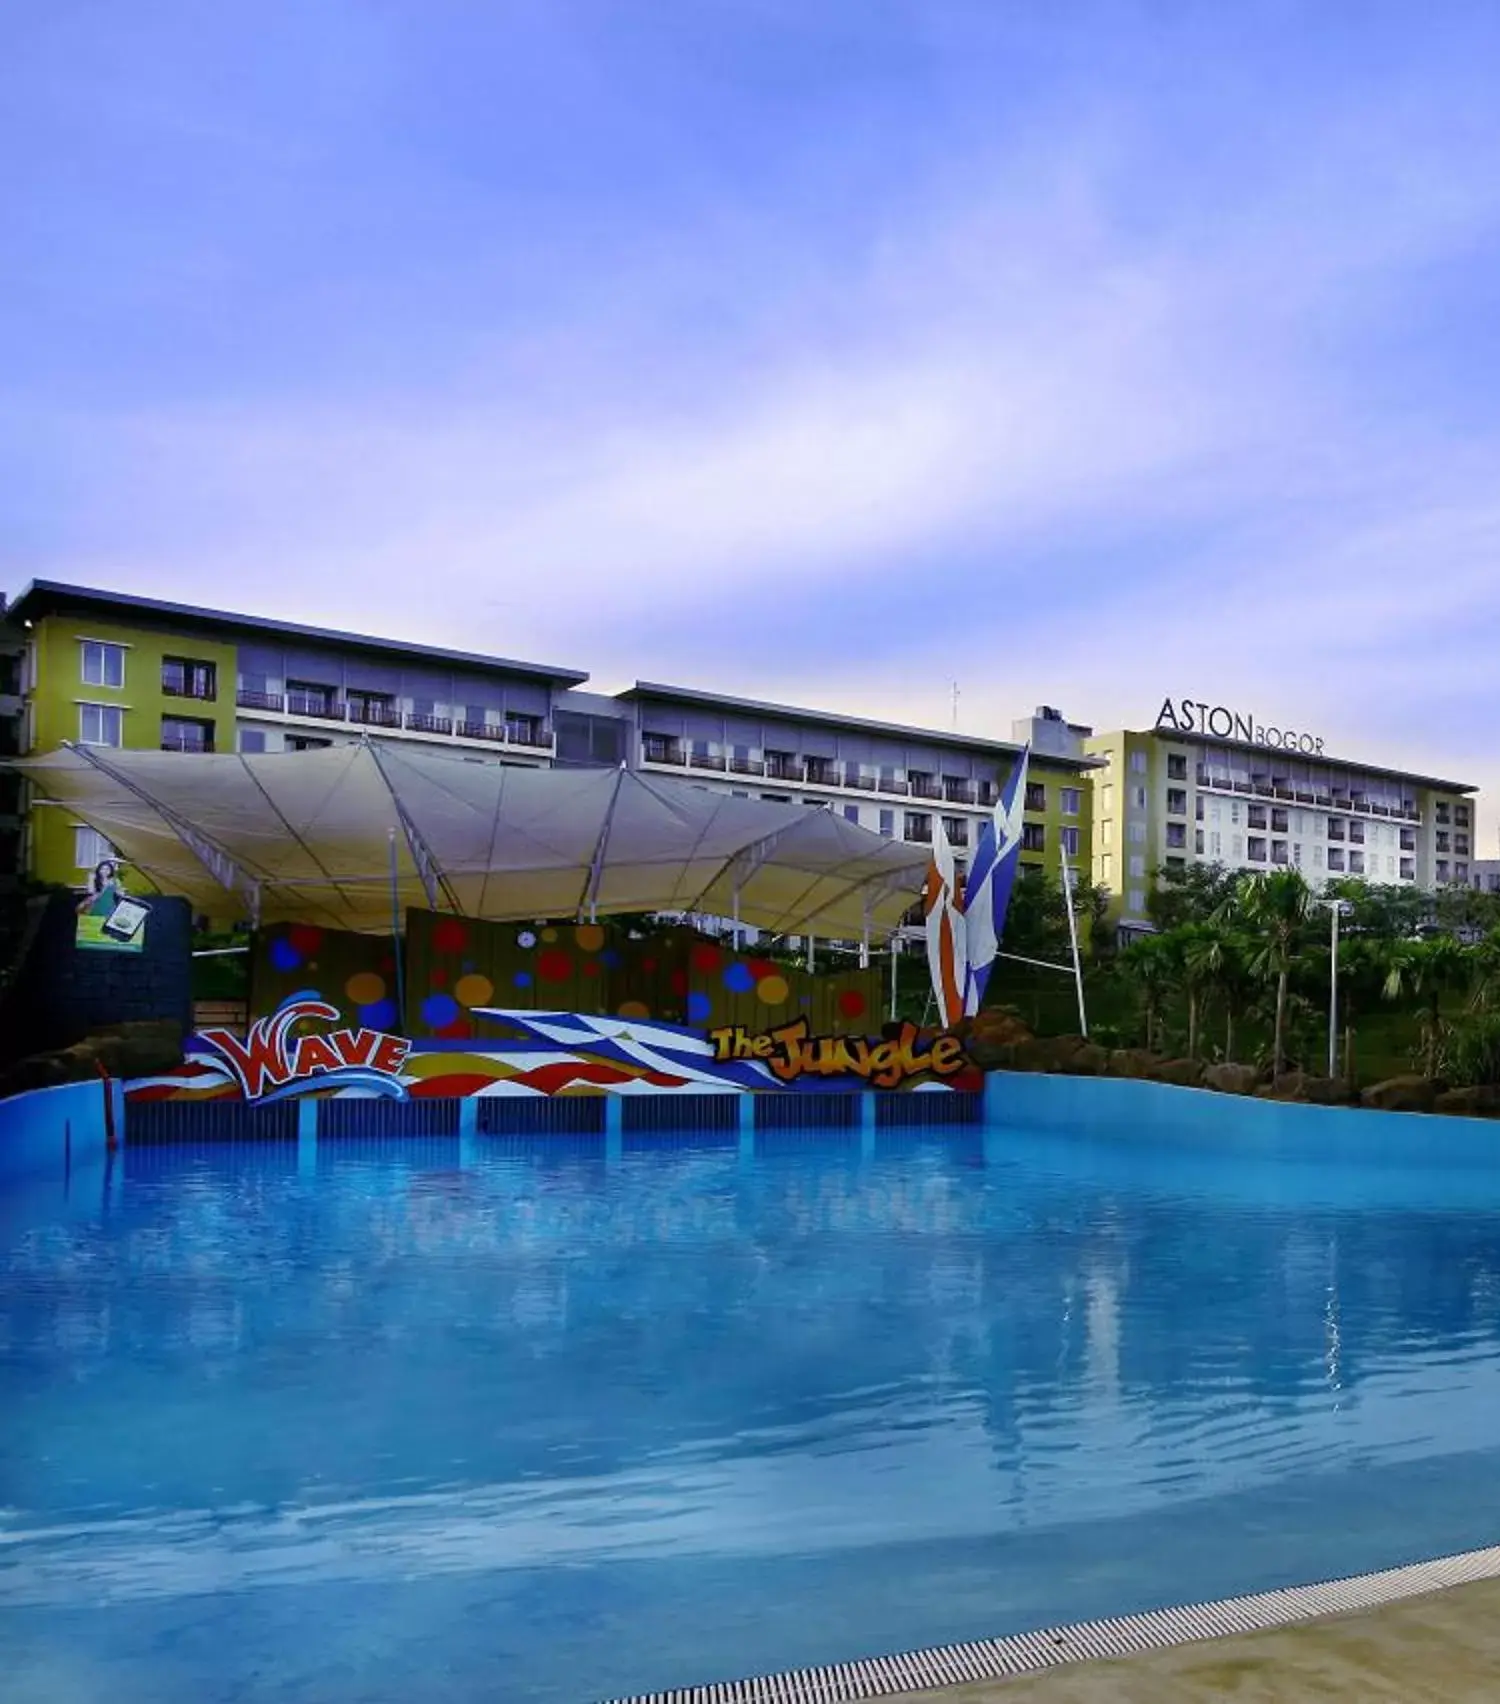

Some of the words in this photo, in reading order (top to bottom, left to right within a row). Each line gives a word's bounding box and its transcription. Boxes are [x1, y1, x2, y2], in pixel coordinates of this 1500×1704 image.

[1156, 698, 1253, 743] ASTON
[1255, 725, 1325, 757] BOGOR
[196, 1001, 412, 1099] WAVE
[711, 1026, 774, 1060] The
